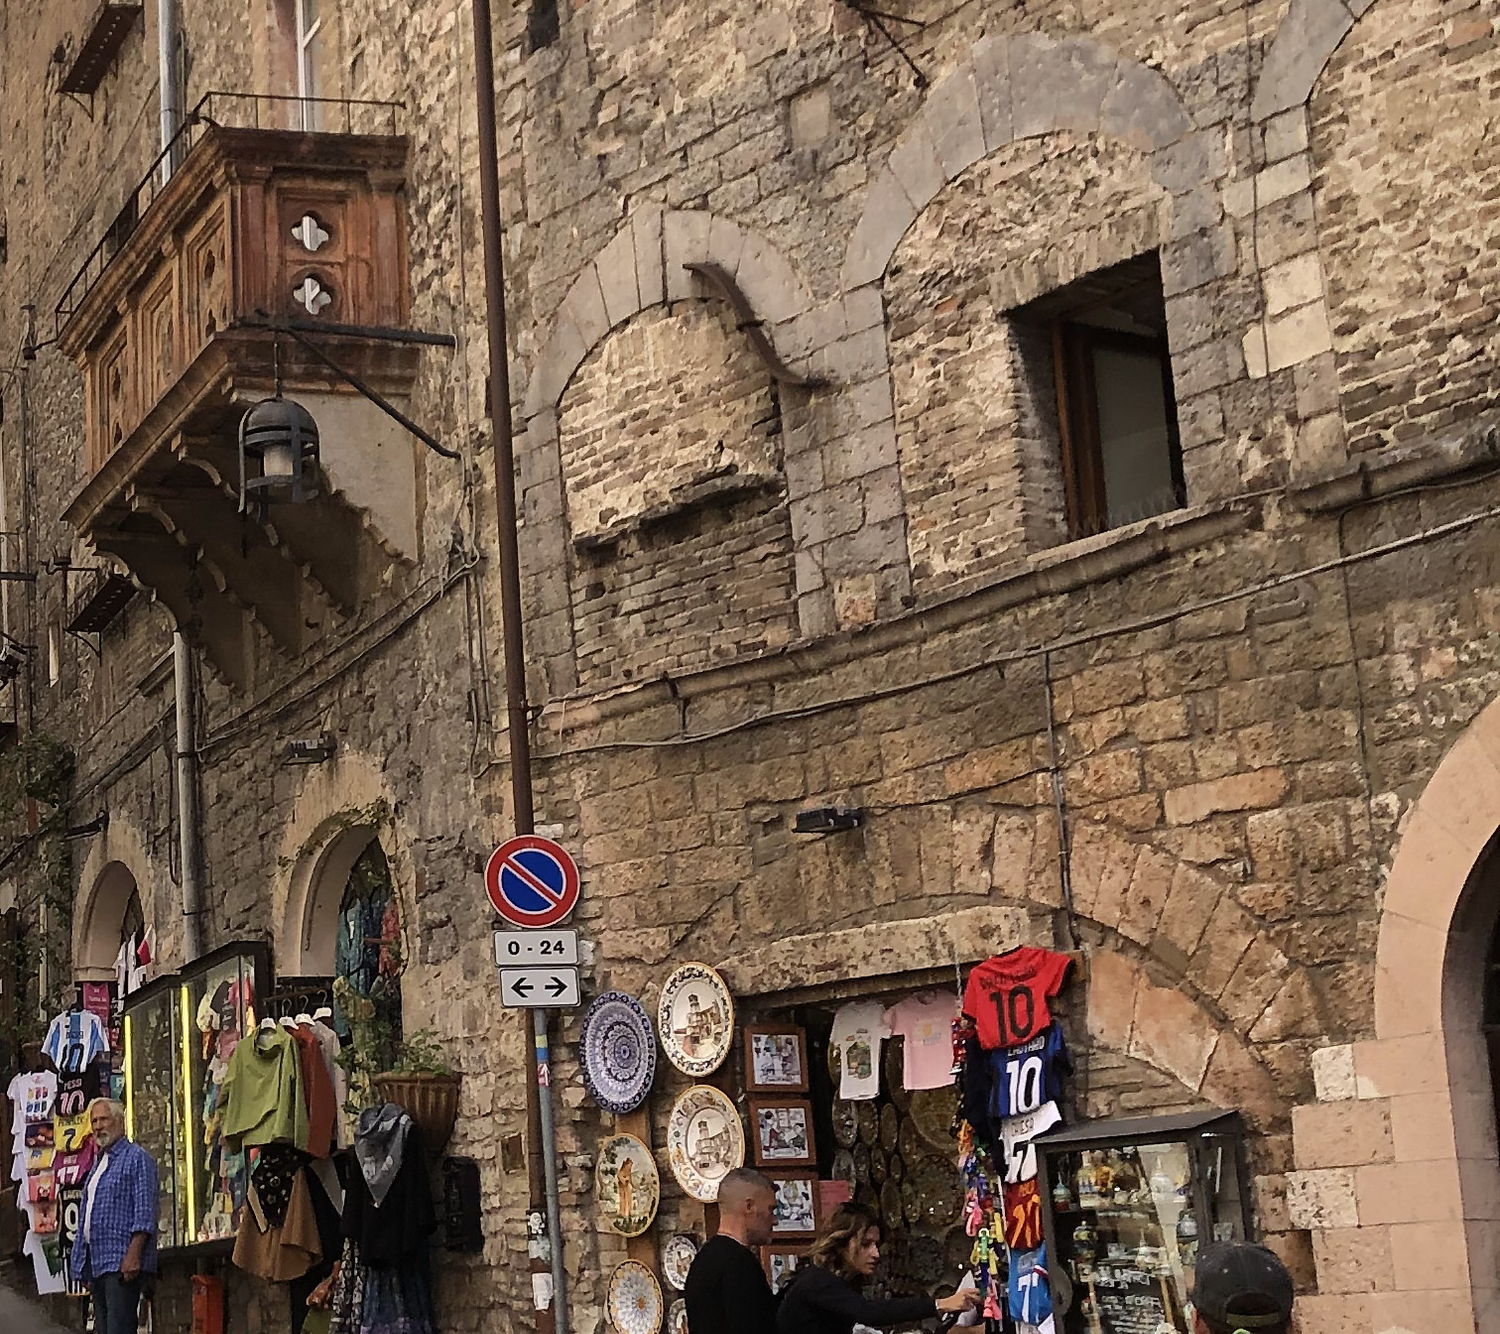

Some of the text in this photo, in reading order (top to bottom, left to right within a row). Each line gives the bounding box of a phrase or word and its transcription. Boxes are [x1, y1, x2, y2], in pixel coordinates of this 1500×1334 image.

[508, 941, 520, 955] 0
[540, 940, 565, 954] 24
[989, 984, 1034, 1044] 10
[60, 1043, 85, 1073] 10
[1006, 1056, 1043, 1117] 10
[60, 1090, 85, 1116] 10
[63, 1128, 77, 1152] 7
[57, 1165, 80, 1185] 17
